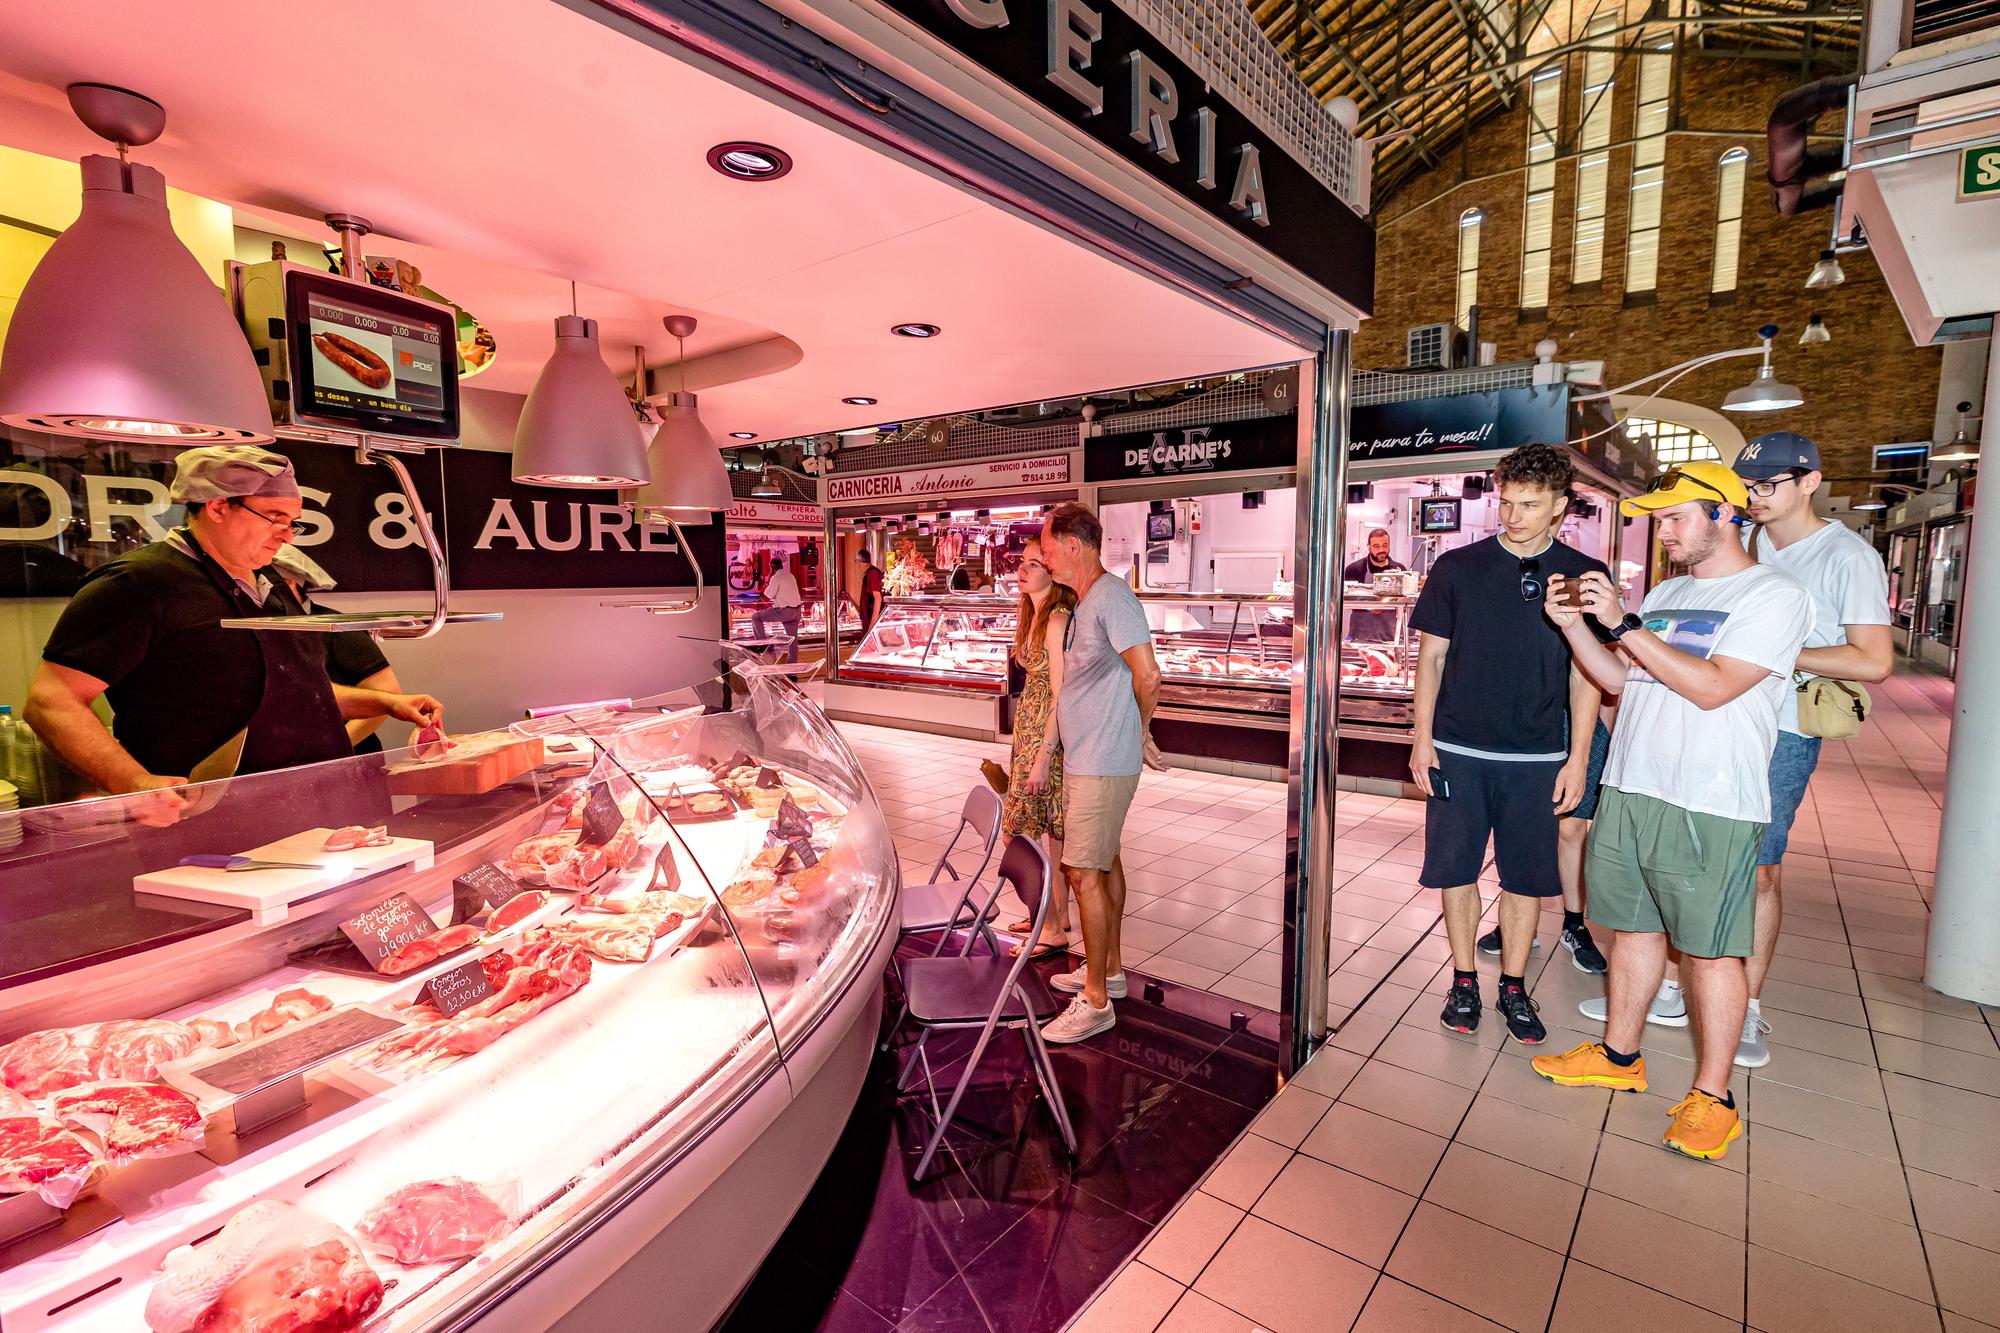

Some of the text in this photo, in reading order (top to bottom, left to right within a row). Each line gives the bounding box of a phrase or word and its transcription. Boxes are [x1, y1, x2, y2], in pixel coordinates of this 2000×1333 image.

[1273, 383, 1287, 398] 61
[327, 392, 349, 402] desea
[381, 401, 397, 410] buen
[931, 431, 943, 443] 60
[1349, 423, 1494, 455] or para tu mesa!!
[989, 463, 1020, 473] SERVICIO
[1029, 458, 1067, 469] DOMICILIO
[1125, 449, 1149, 466] DE
[1030, 473, 1044, 482] 514
[1057, 471, 1067, 479] 99
[829, 474, 977, 499] CARNICERIA Antonio
[776, 505, 816, 513] TERNERA
[368, 492, 433, 549] &
[363, 901, 409, 935] de ternera
[377, 910, 415, 942] gallega
